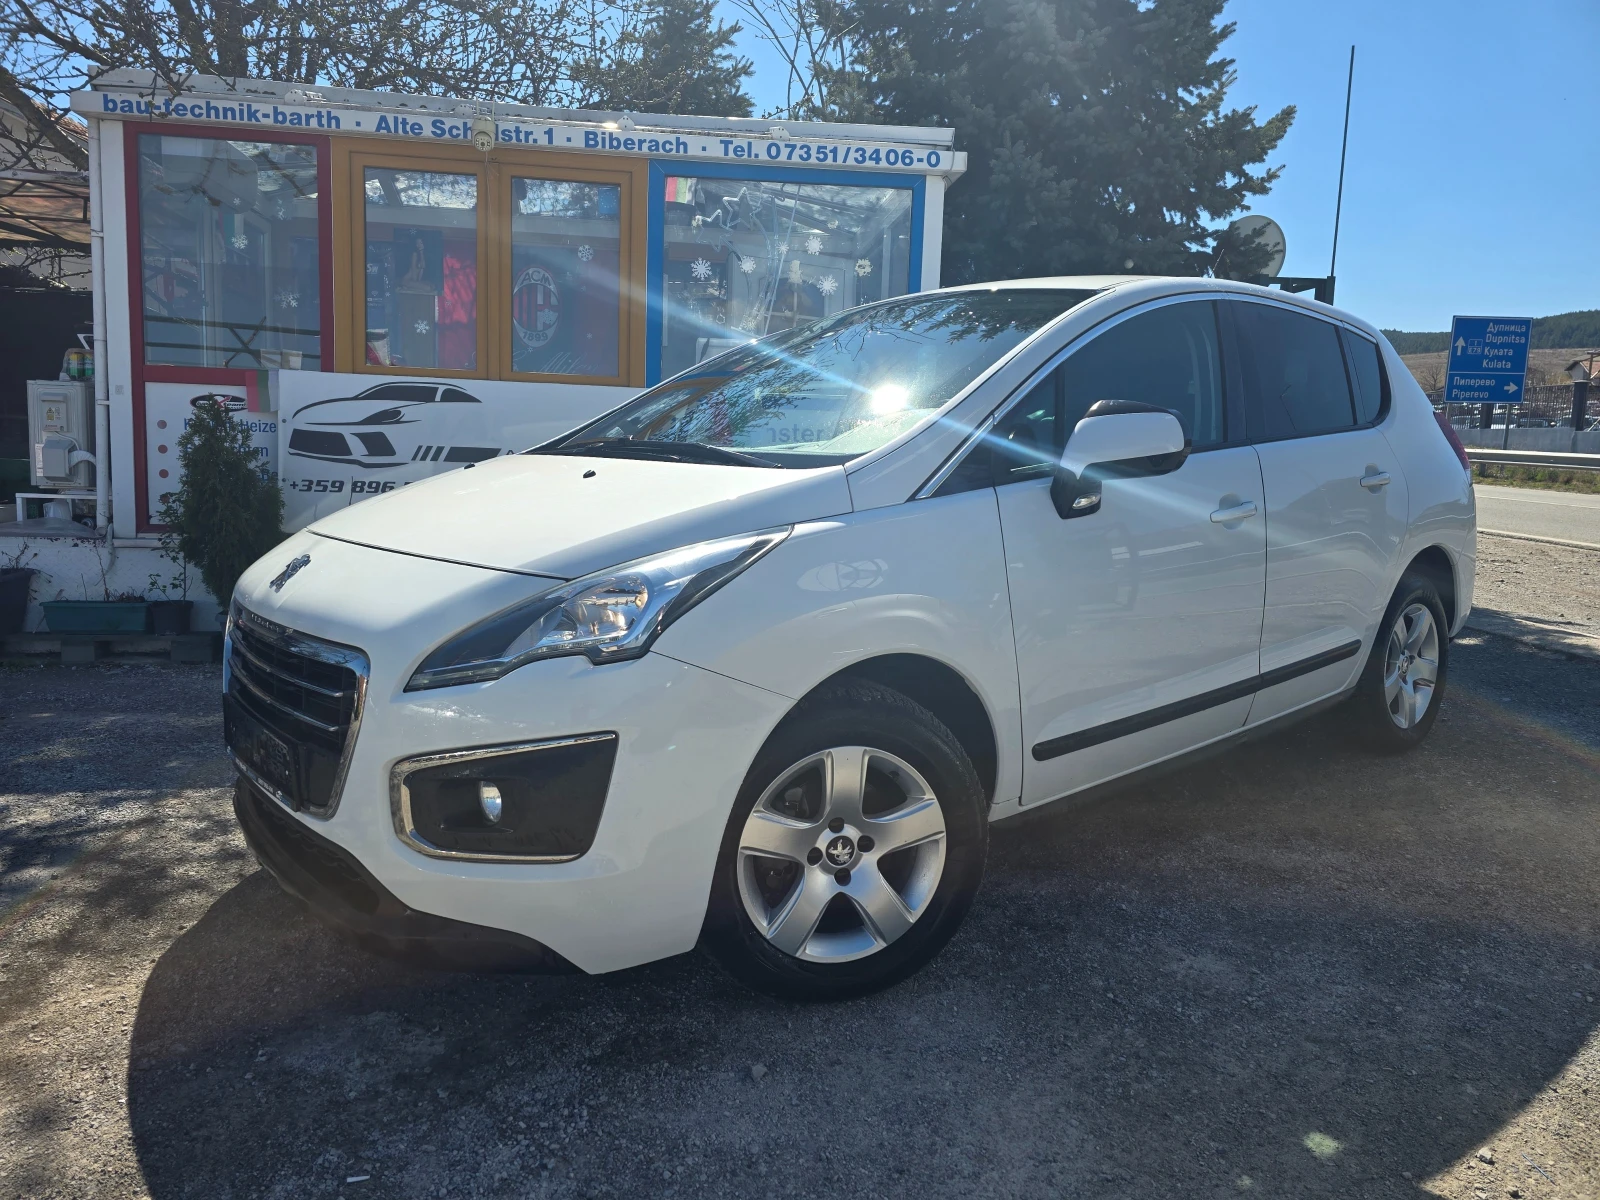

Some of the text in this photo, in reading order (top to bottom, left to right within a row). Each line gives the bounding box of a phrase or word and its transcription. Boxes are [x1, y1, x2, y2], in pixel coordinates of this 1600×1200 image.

[102, 93, 341, 130] bau-technik-barth
[375, 115, 424, 136] Alte
[430, 118, 538, 144] Schlstr.
[584, 130, 689, 154] Biberach
[719, 139, 760, 159] Tel.
[766, 142, 941, 168] 07351/3406-0
[521, 270, 551, 285] ACM
[1486, 322, 1526, 333] Дупница
[522, 331, 548, 342] 1899
[1485, 333, 1526, 344] Dupnitsa
[1484, 346, 1514, 357] Кулата
[1482, 359, 1511, 368] Kulata
[1453, 376, 1496, 387] Пиперево
[1452, 389, 1489, 399] Piperevo
[289, 479, 345, 493] +359
[351, 480, 396, 494] 896
